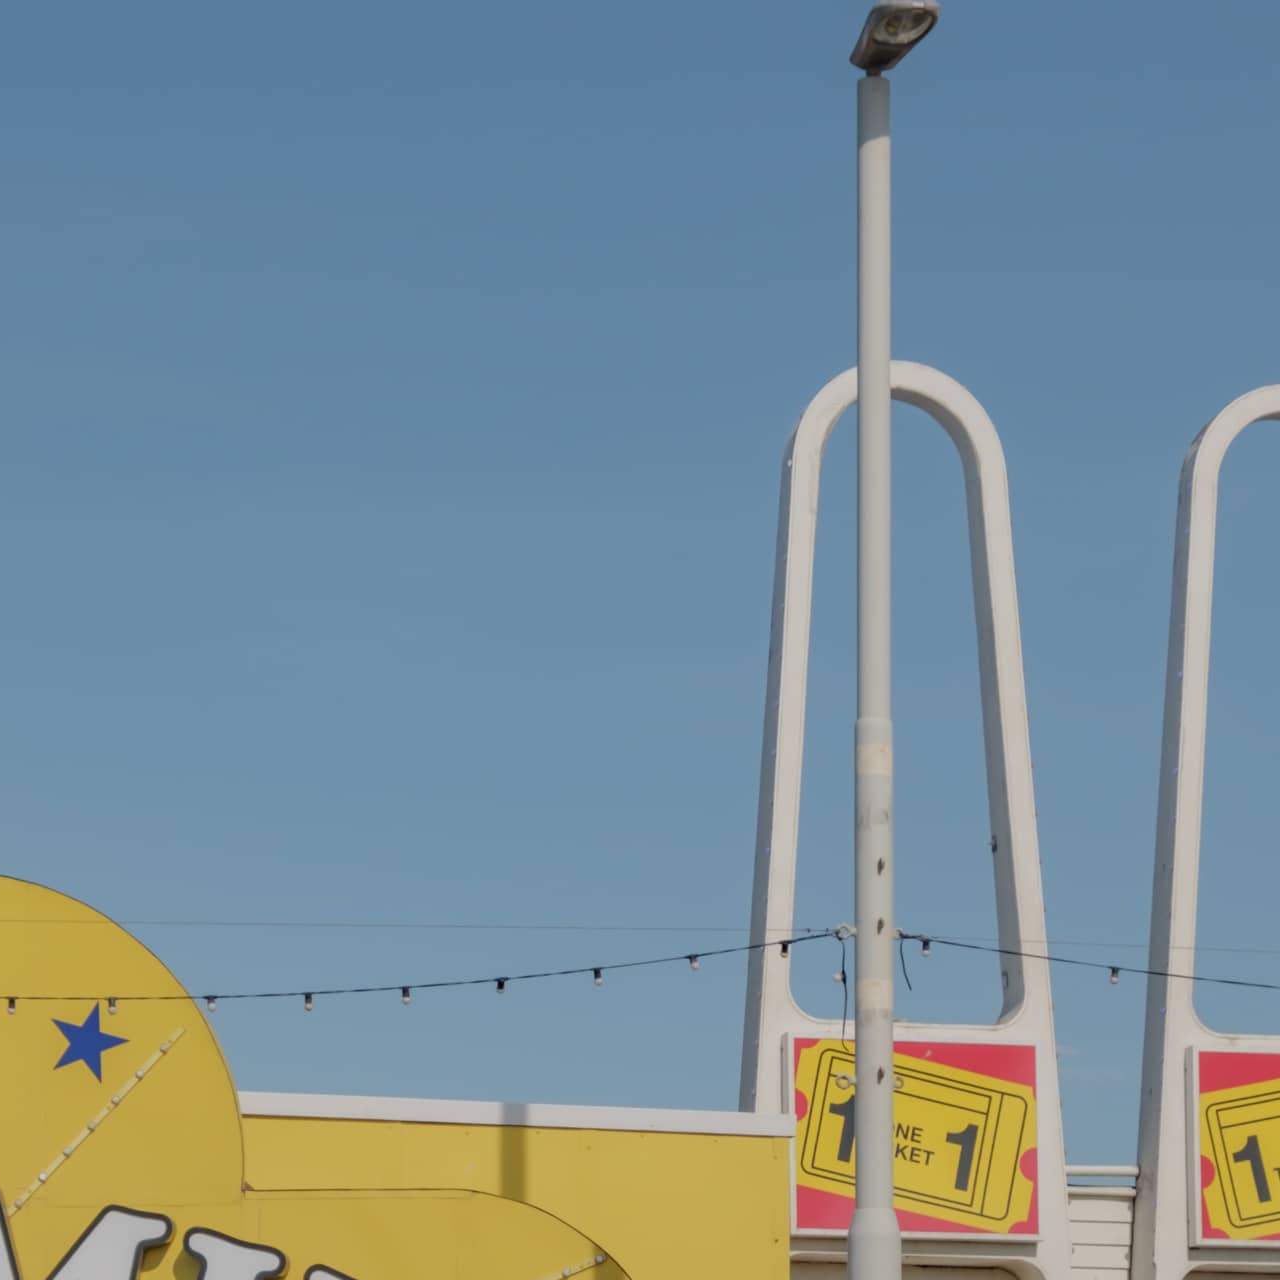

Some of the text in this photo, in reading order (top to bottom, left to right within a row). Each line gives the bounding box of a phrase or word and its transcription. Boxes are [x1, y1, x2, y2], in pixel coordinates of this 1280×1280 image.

[893, 1123, 924, 1143] NE
[895, 1143, 935, 1166] KET
[946, 1123, 979, 1191] 1
[1232, 1134, 1272, 1203] 1
